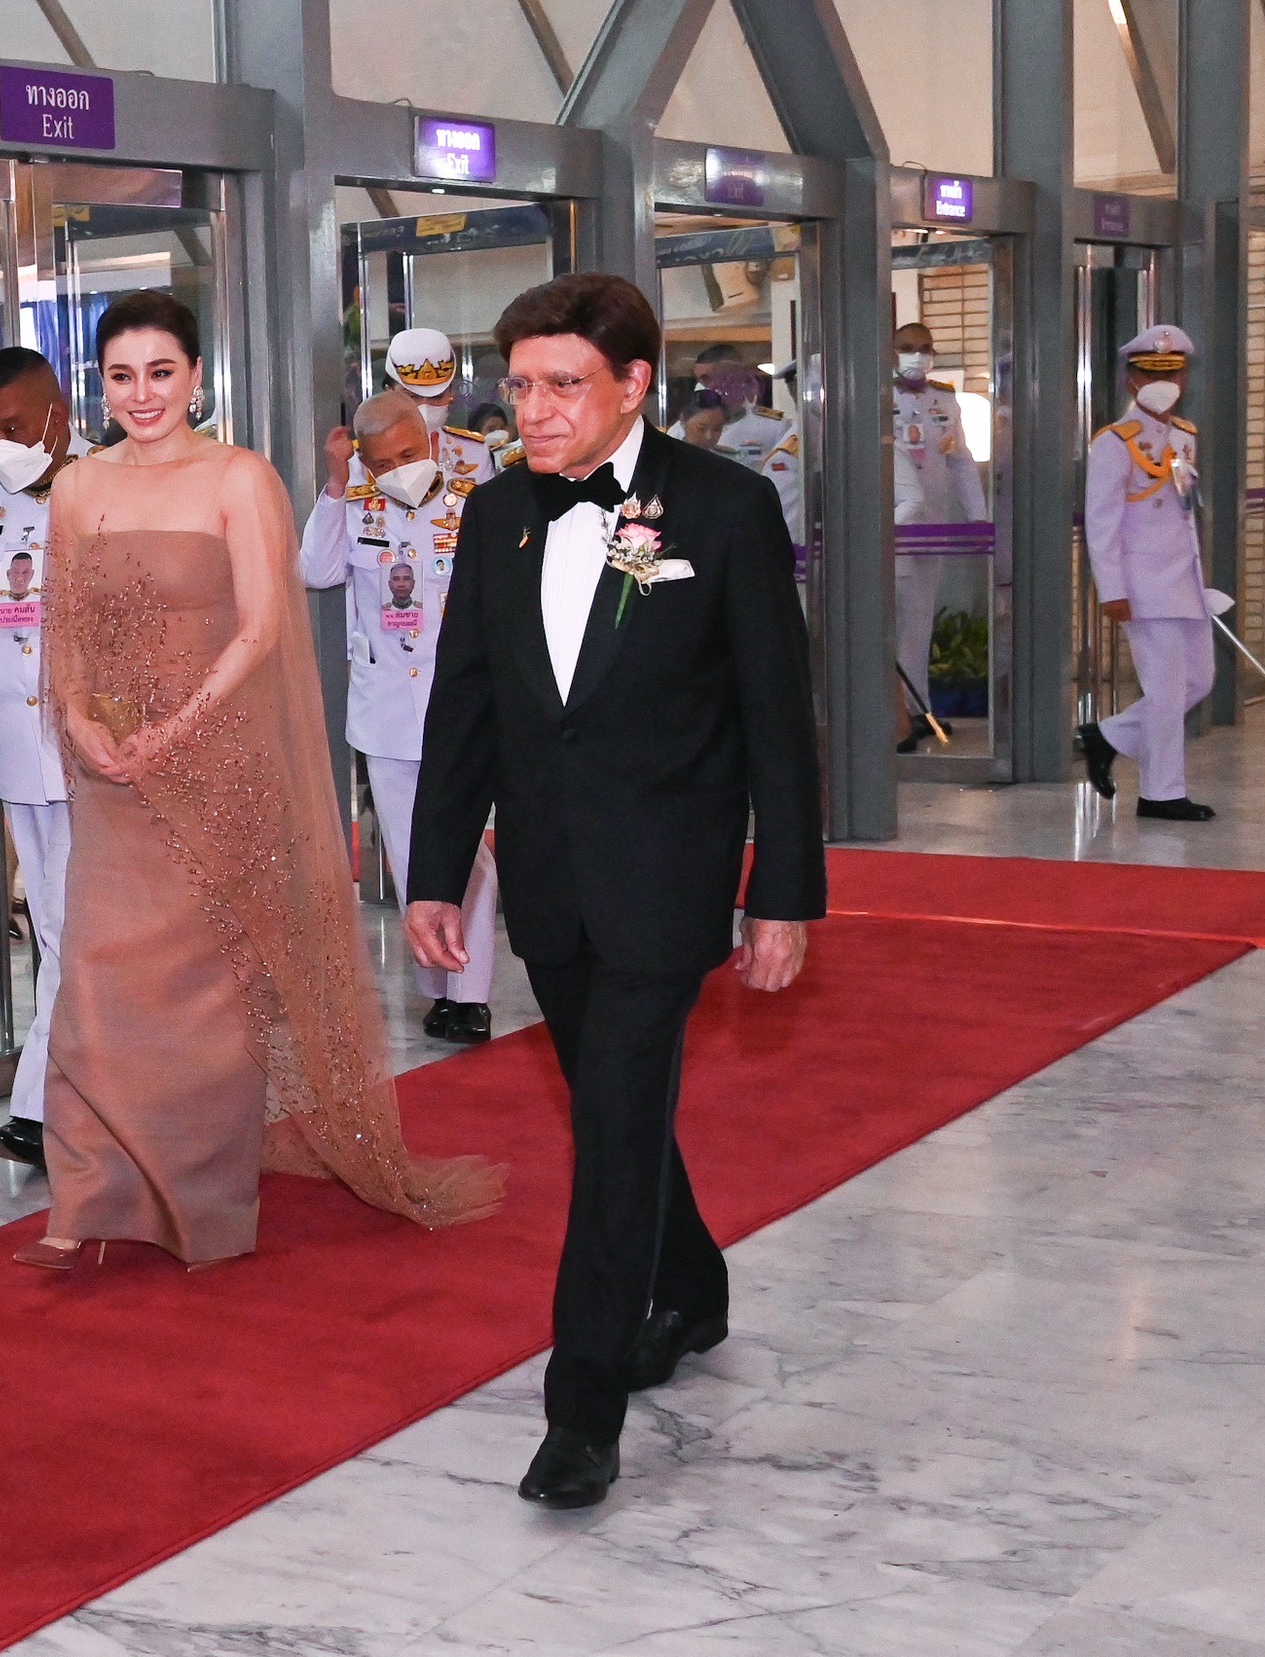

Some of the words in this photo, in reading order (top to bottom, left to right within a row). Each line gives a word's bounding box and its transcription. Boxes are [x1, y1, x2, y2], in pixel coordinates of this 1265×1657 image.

[25, 84, 90, 110] ทางออก
[42, 113, 74, 139] Exit
